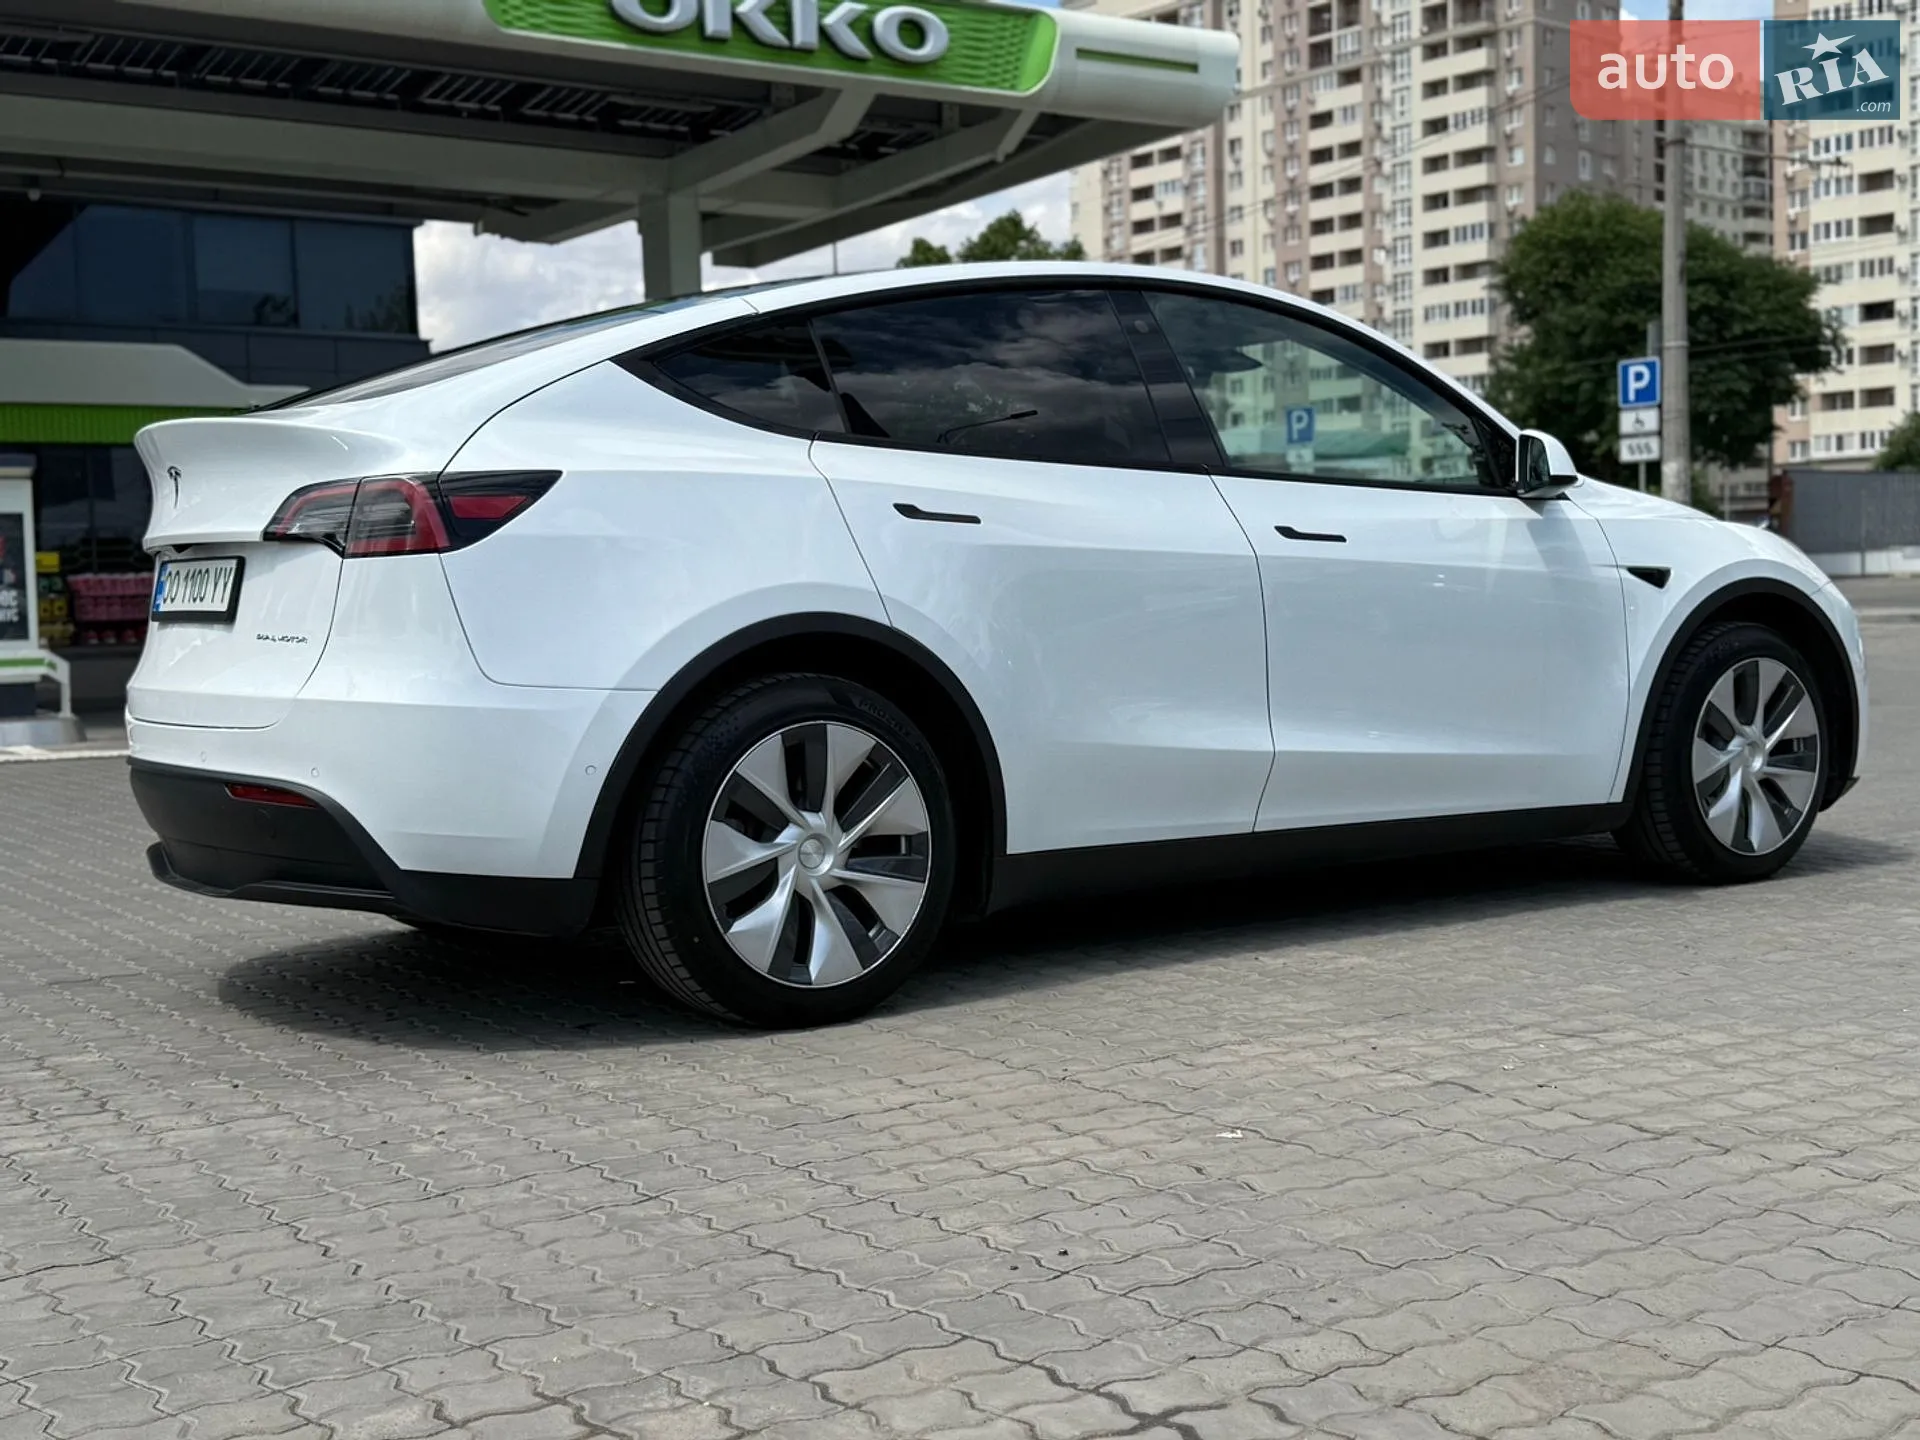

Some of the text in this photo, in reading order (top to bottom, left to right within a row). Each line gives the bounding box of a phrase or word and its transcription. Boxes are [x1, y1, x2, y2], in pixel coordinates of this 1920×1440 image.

[1628, 364, 1651, 402] P
[1290, 410, 1309, 441] P
[182, 568, 209, 603] 1100
[211, 567, 233, 603] YY
